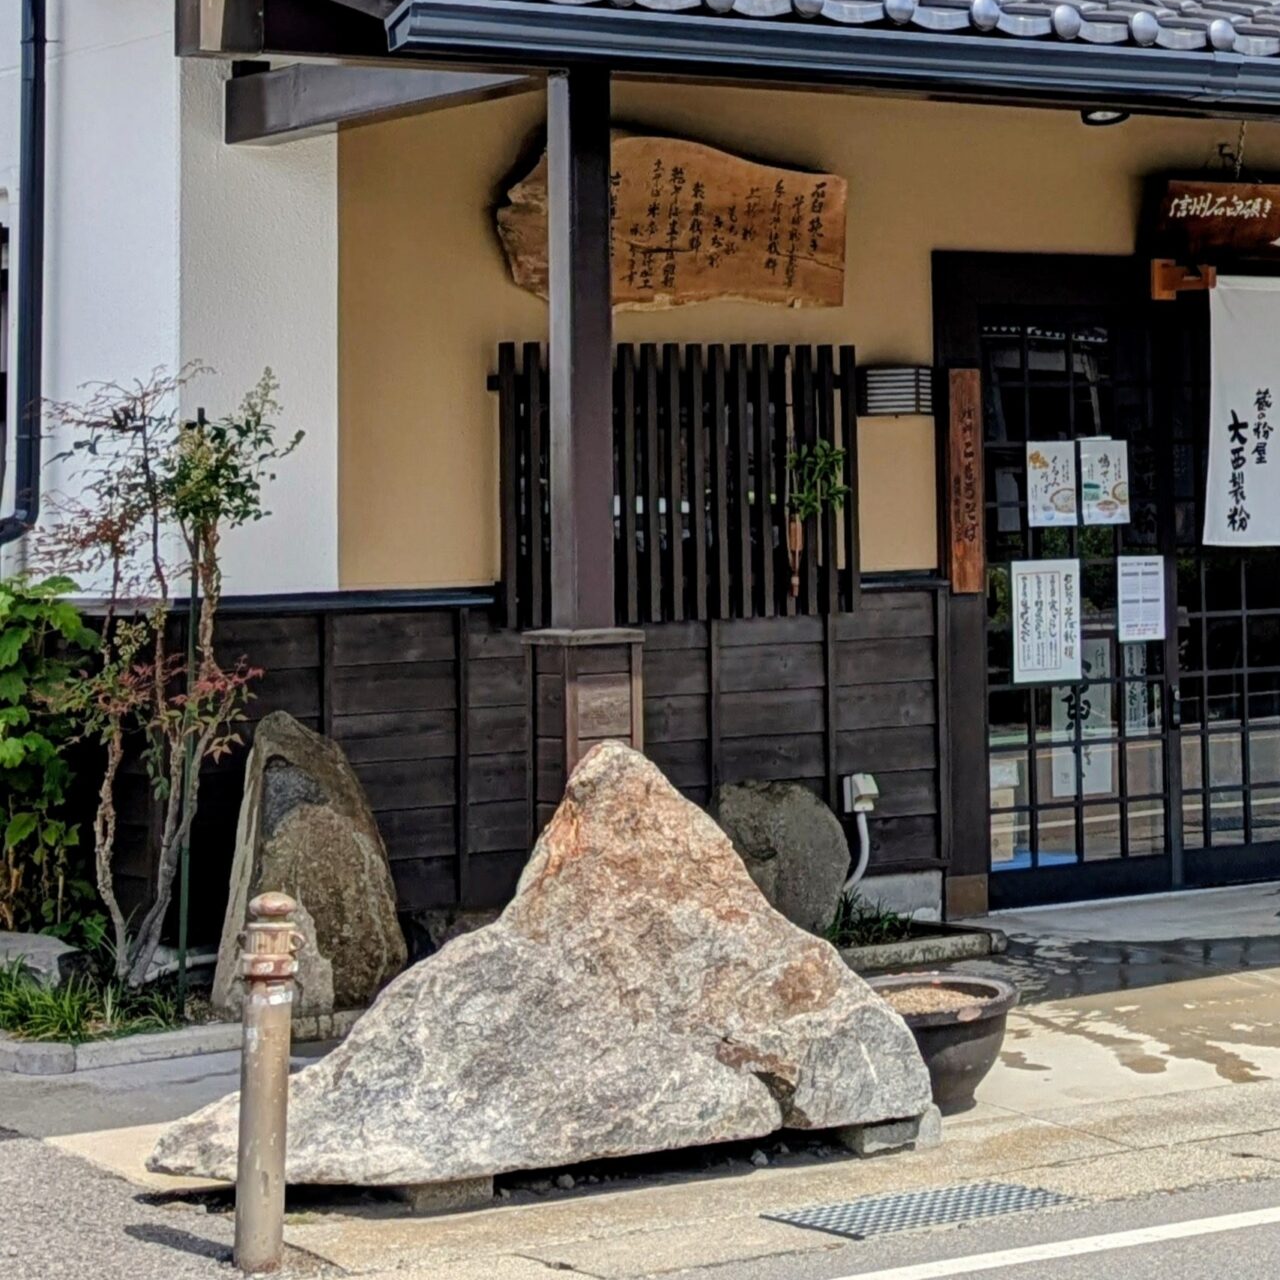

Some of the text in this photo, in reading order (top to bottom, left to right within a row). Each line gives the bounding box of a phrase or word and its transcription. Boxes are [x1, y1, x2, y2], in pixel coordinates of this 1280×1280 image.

[1227, 409, 1250, 532] 大西製粉
[1251, 388, 1273, 464] 蔵の粉屋
